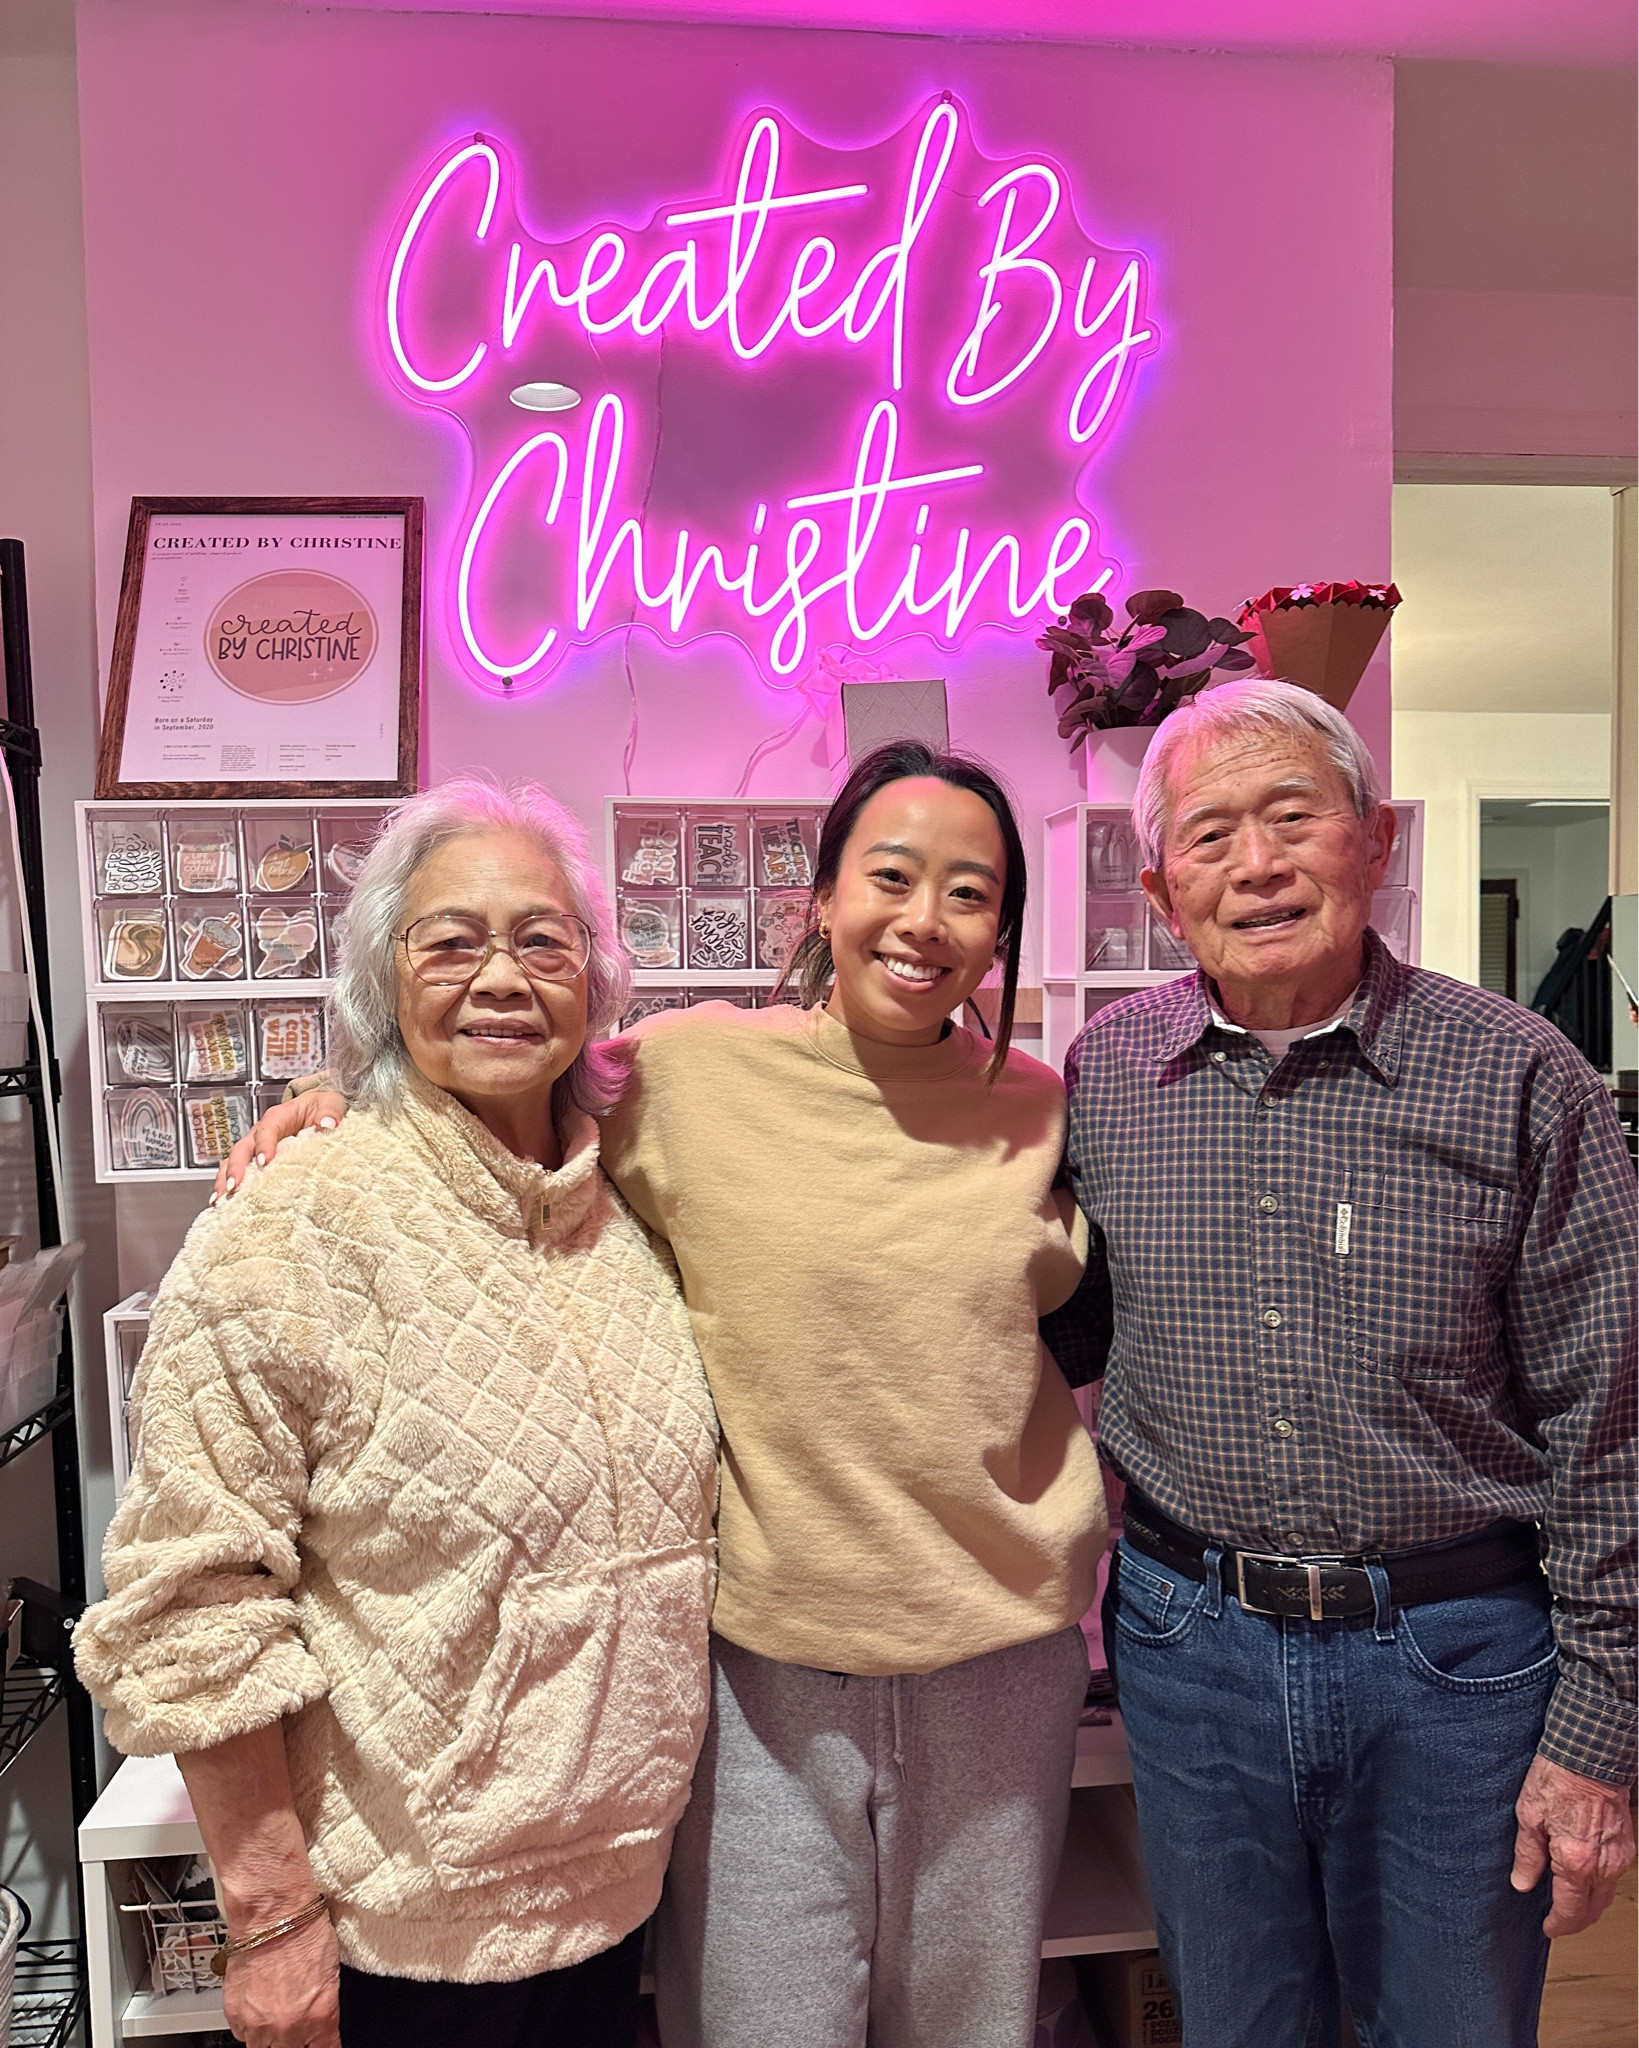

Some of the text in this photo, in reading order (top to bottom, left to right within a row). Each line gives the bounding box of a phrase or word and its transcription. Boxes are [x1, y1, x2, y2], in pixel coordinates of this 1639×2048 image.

[387, 101, 1153, 445] Created By
[153, 537, 402, 549] CREATED BY CHRISTINE
[458, 393, 1114, 676] Christine
[221, 609, 362, 636] created
[218, 636, 361, 662] BY CHRISTINE
[186, 716, 214, 724] Saturday
[697, 824, 723, 886] TEACH
[760, 825, 789, 885] HEART
[191, 1108, 207, 1157] hold on
[203, 1110, 215, 1134] me
[1143, 2000, 1175, 2020] 26
